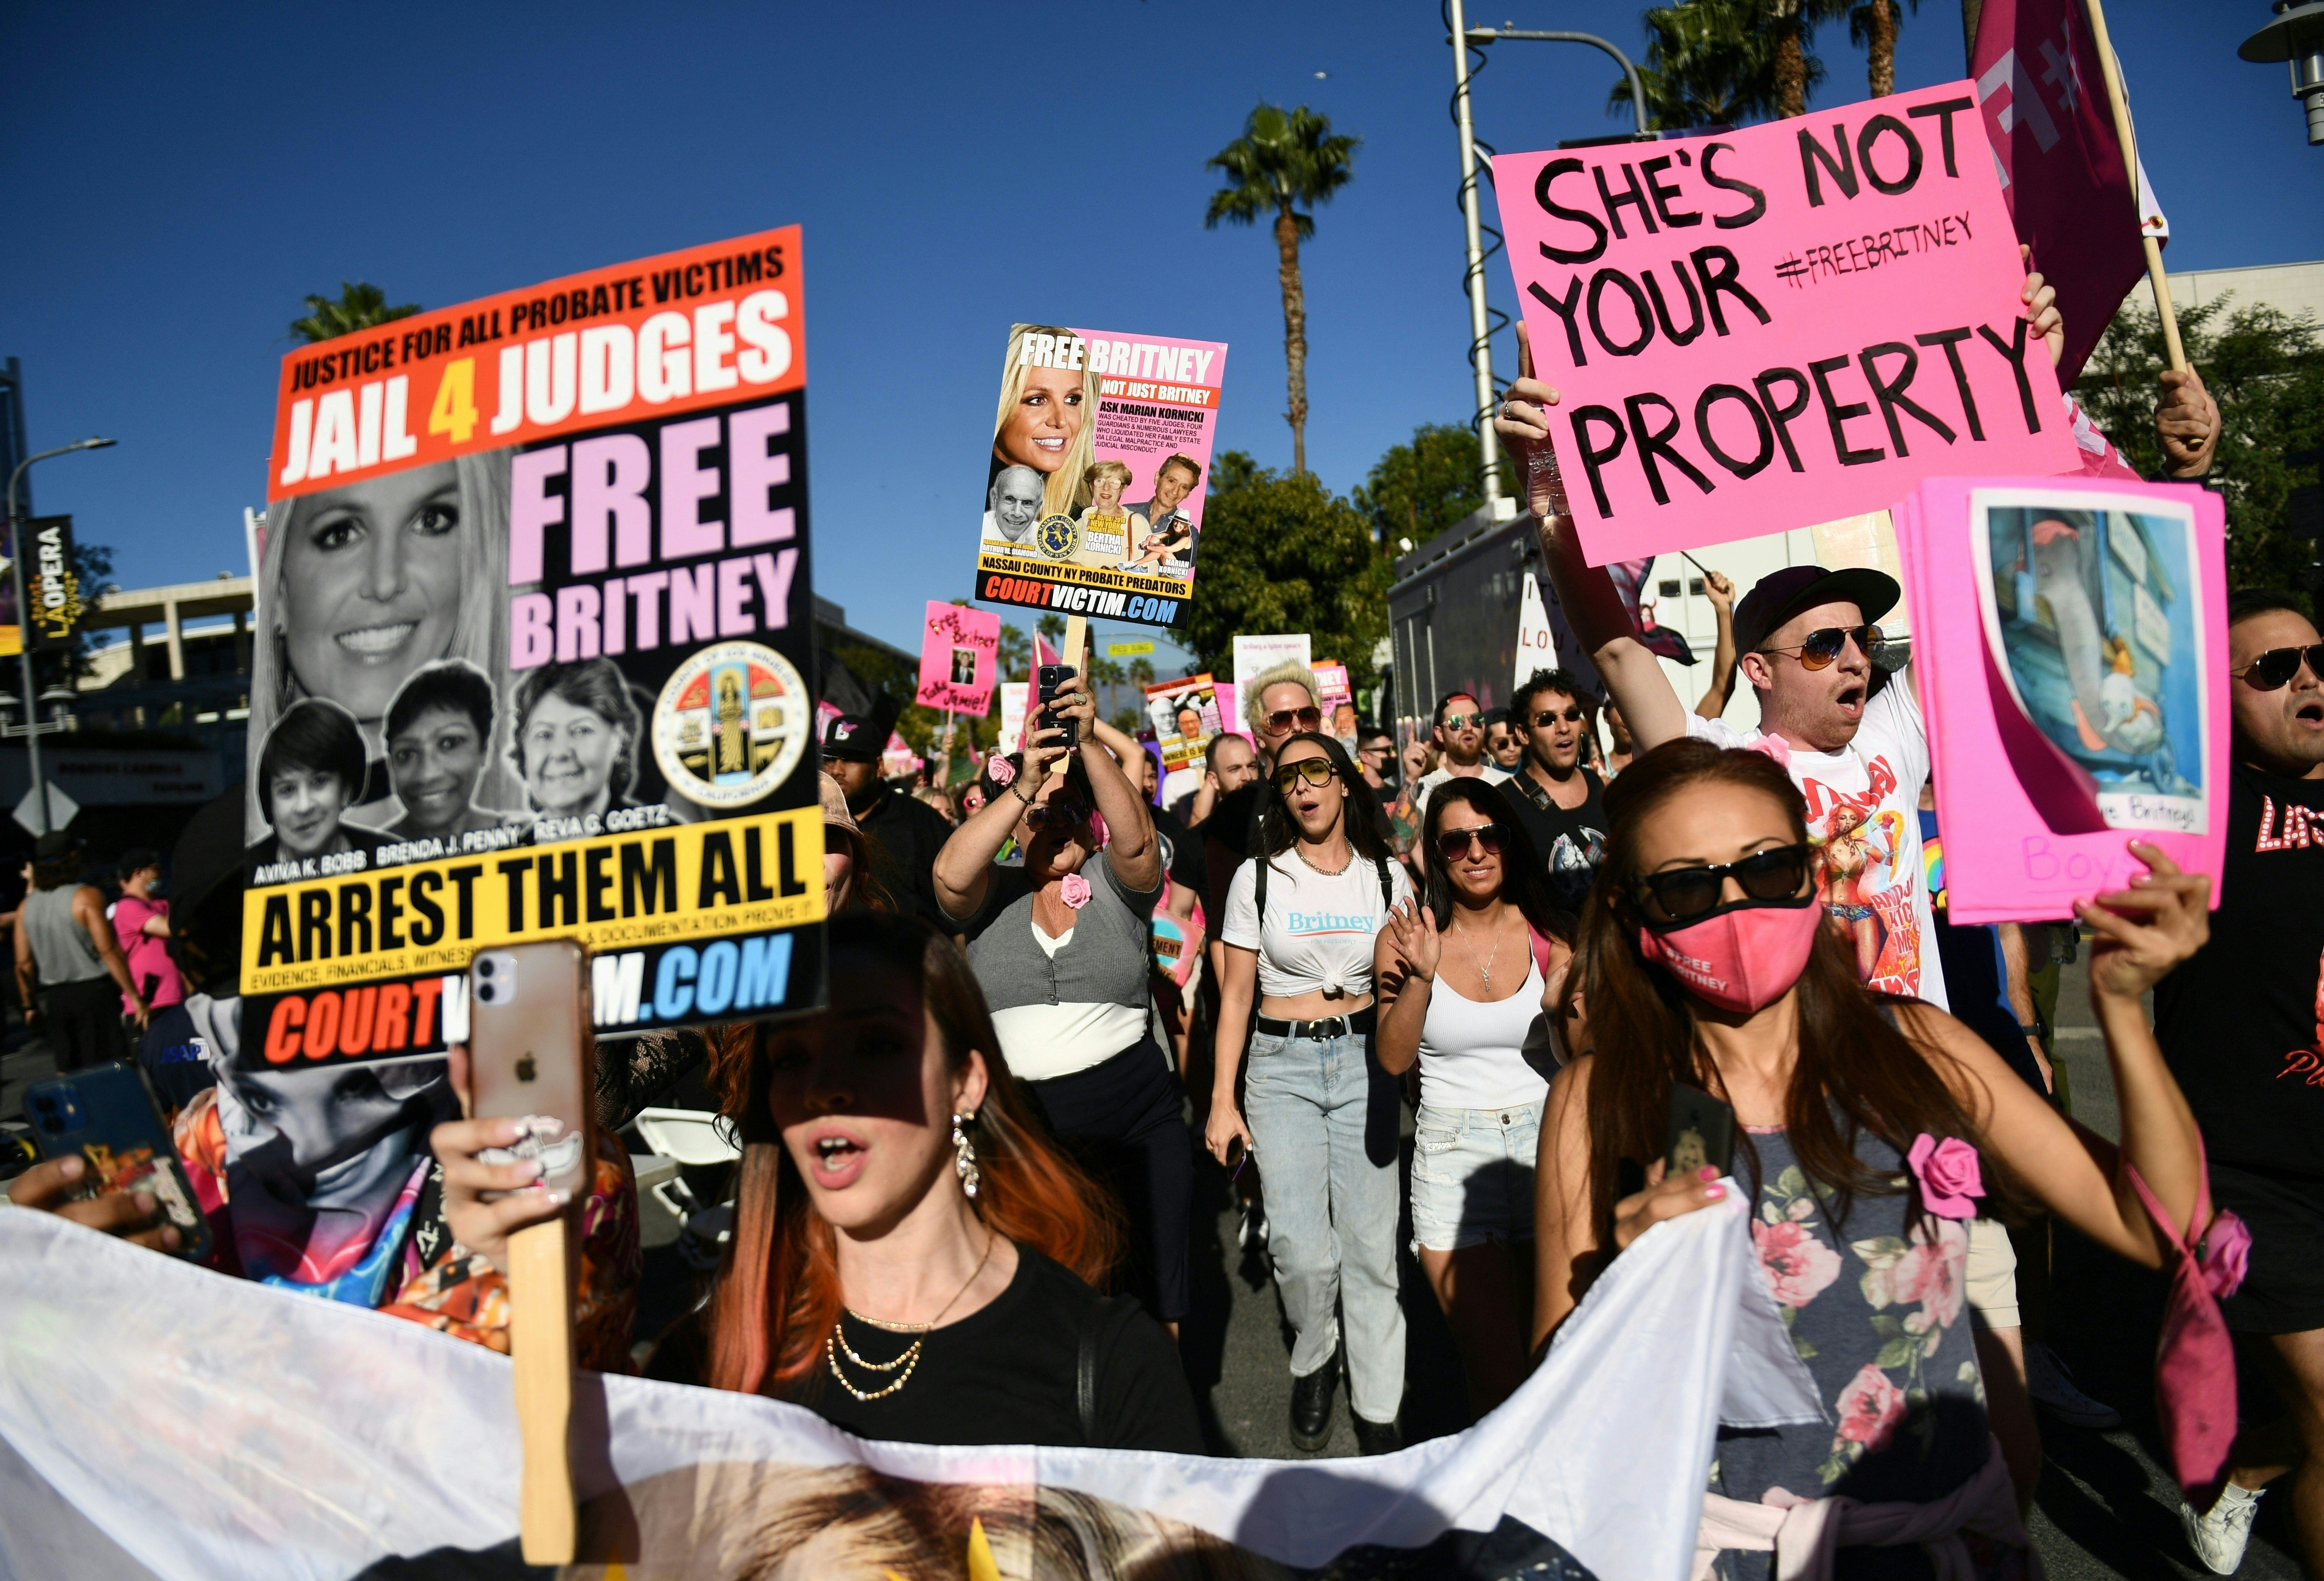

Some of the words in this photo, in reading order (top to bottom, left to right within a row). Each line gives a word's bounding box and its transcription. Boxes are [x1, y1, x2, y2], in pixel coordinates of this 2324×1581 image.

[1534, 141, 1767, 265] SHE'S
[1797, 96, 1974, 208] NOT
[1775, 211, 1972, 288] #FREEBRITNEY
[1527, 245, 1772, 367] YOUR
[291, 338, 394, 393] JUSTICE
[401, 324, 450, 364] FOR
[458, 310, 502, 350] ALL
[511, 275, 644, 336] PROBATE
[652, 246, 784, 303] VICTIMS
[1019, 333, 1086, 371] FREE
[1088, 339, 1214, 384] BRITNEY
[280, 374, 416, 486] JAIL
[428, 357, 478, 444] 4
[490, 289, 793, 435] JUDGES
[1101, 379, 1126, 395] NOT
[1126, 383, 1156, 399] JUST
[1158, 386, 1211, 405] BRITNEY
[1100, 401, 1119, 412] ASK
[1120, 404, 1157, 417] MARIAN
[1158, 408, 1204, 423] KORNICKI
[1162, 420, 1185, 428] JUDGES,
[1570, 316, 2041, 519] PROPERTY
[1098, 420, 1130, 429] GUARDIANS
[1137, 425, 1168, 433] NUMEROUS
[1111, 429, 1144, 437] LIQUIDATED
[1120, 444, 1157, 453] MISCONDUCT
[1125, 438, 1164, 447] MALPRACTICE
[508, 401, 796, 586] FREE
[1039, 516, 1058, 531] NASSAU
[1061, 517, 1077, 535] COUNTY
[1105, 521, 1120, 529] YORK
[982, 544, 1004, 553] ARTHUR
[1012, 548, 1038, 558] DIAMOND
[1068, 538, 1077, 553] YORK
[1085, 541, 1121, 555] KORNICKI
[1088, 532, 1121, 546] BERTHA
[1159, 566, 1188, 576] KORNICKI
[1165, 558, 1189, 568] MARIAN
[983, 558, 1021, 572] NASSAU
[1023, 563, 1063, 578] COUNTY
[1064, 567, 1077, 579] NY
[1079, 570, 1124, 587] PROBATE
[1126, 576, 1185, 595] PREDATORS
[509, 547, 799, 671] BRITNEY
[985, 576, 1178, 623] COURTVICTIM.COM
[321, 849, 368, 875] BOBB
[376, 836, 444, 867] BRENDA
[464, 825, 520, 851] PENNY
[534, 817, 584, 840] REVA
[606, 804, 670, 831] GOETZ
[258, 864, 482, 967] ARREST
[497, 838, 677, 932] THEM
[699, 821, 806, 908] ALL
[600, 915, 738, 943] DOCUMENTATION
[743, 906, 797, 926] PROVE
[1288, 910, 1373, 934] Britney
